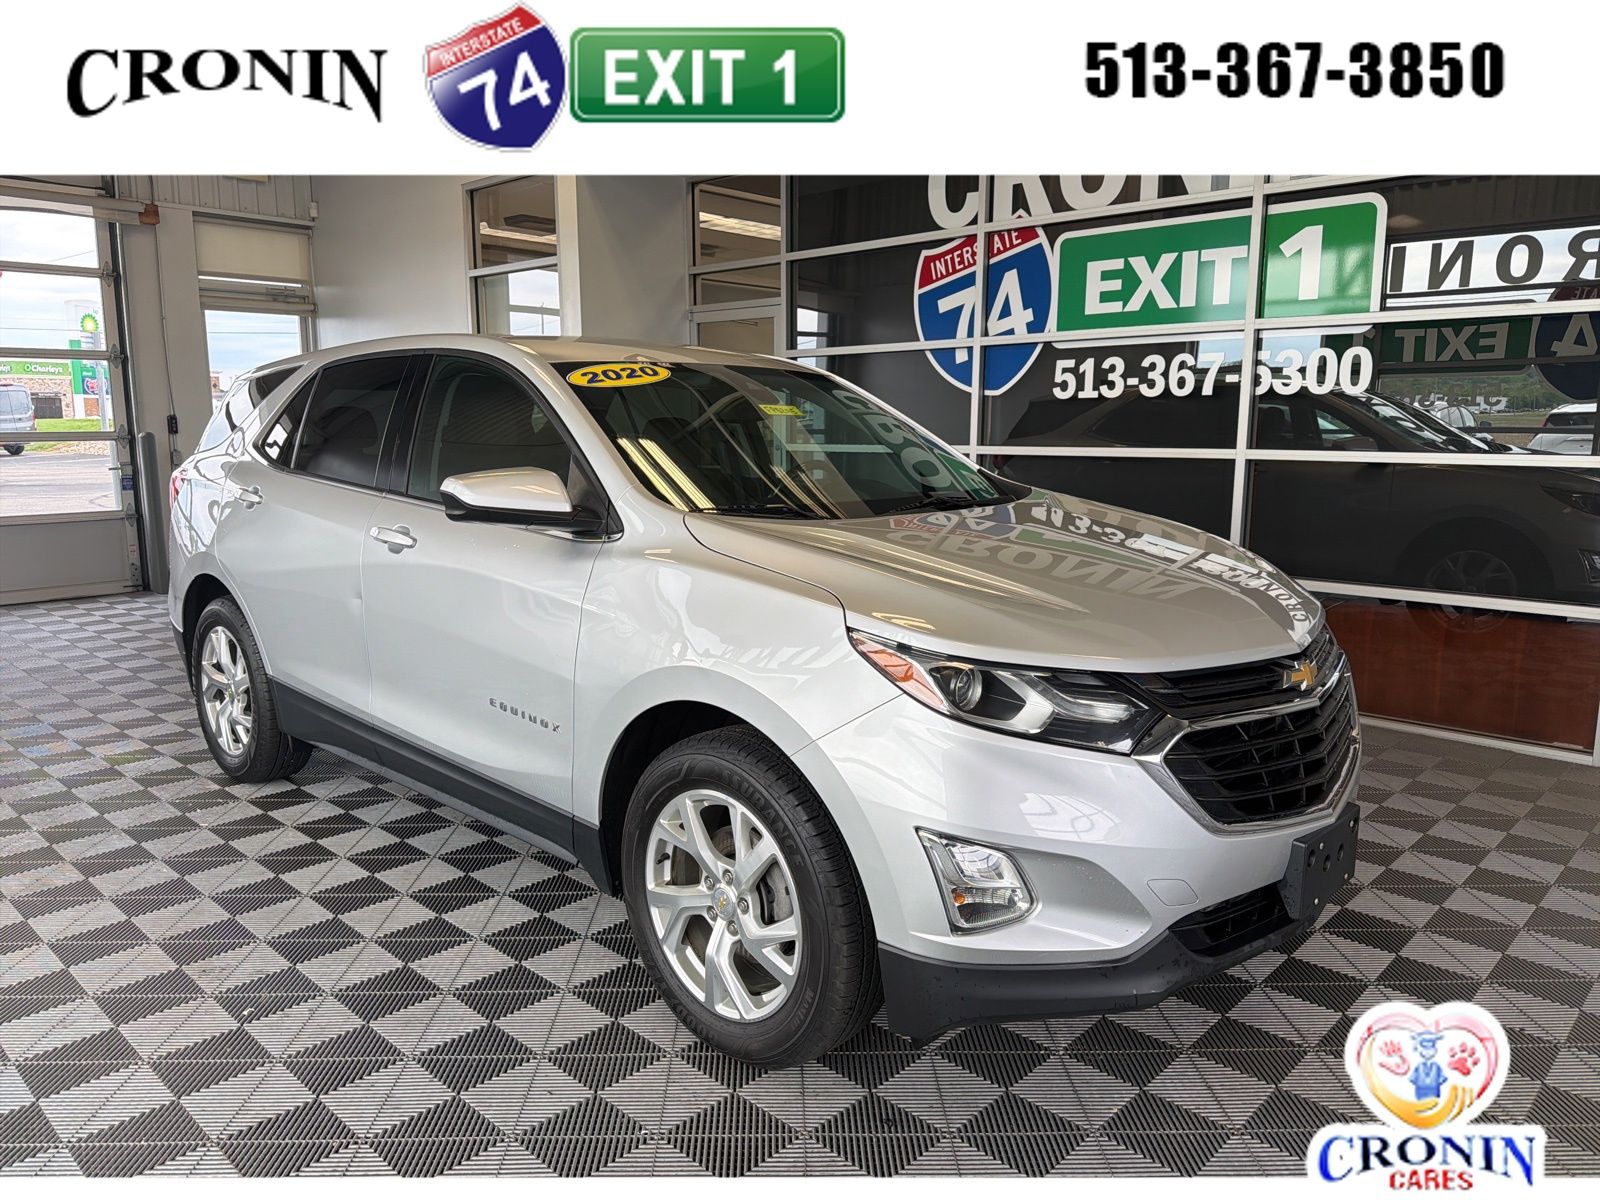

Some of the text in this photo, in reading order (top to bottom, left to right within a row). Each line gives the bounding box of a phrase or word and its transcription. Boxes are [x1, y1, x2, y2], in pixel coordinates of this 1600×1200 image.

[930, 228, 1023, 281] INTERSATE
[1085, 225, 1324, 315] EXIT 1
[937, 268, 1033, 364] 74
[580, 364, 661, 385] 2020
[1052, 346, 1373, 400] 513-367-5300
[489, 697, 561, 734] EQUINOX
